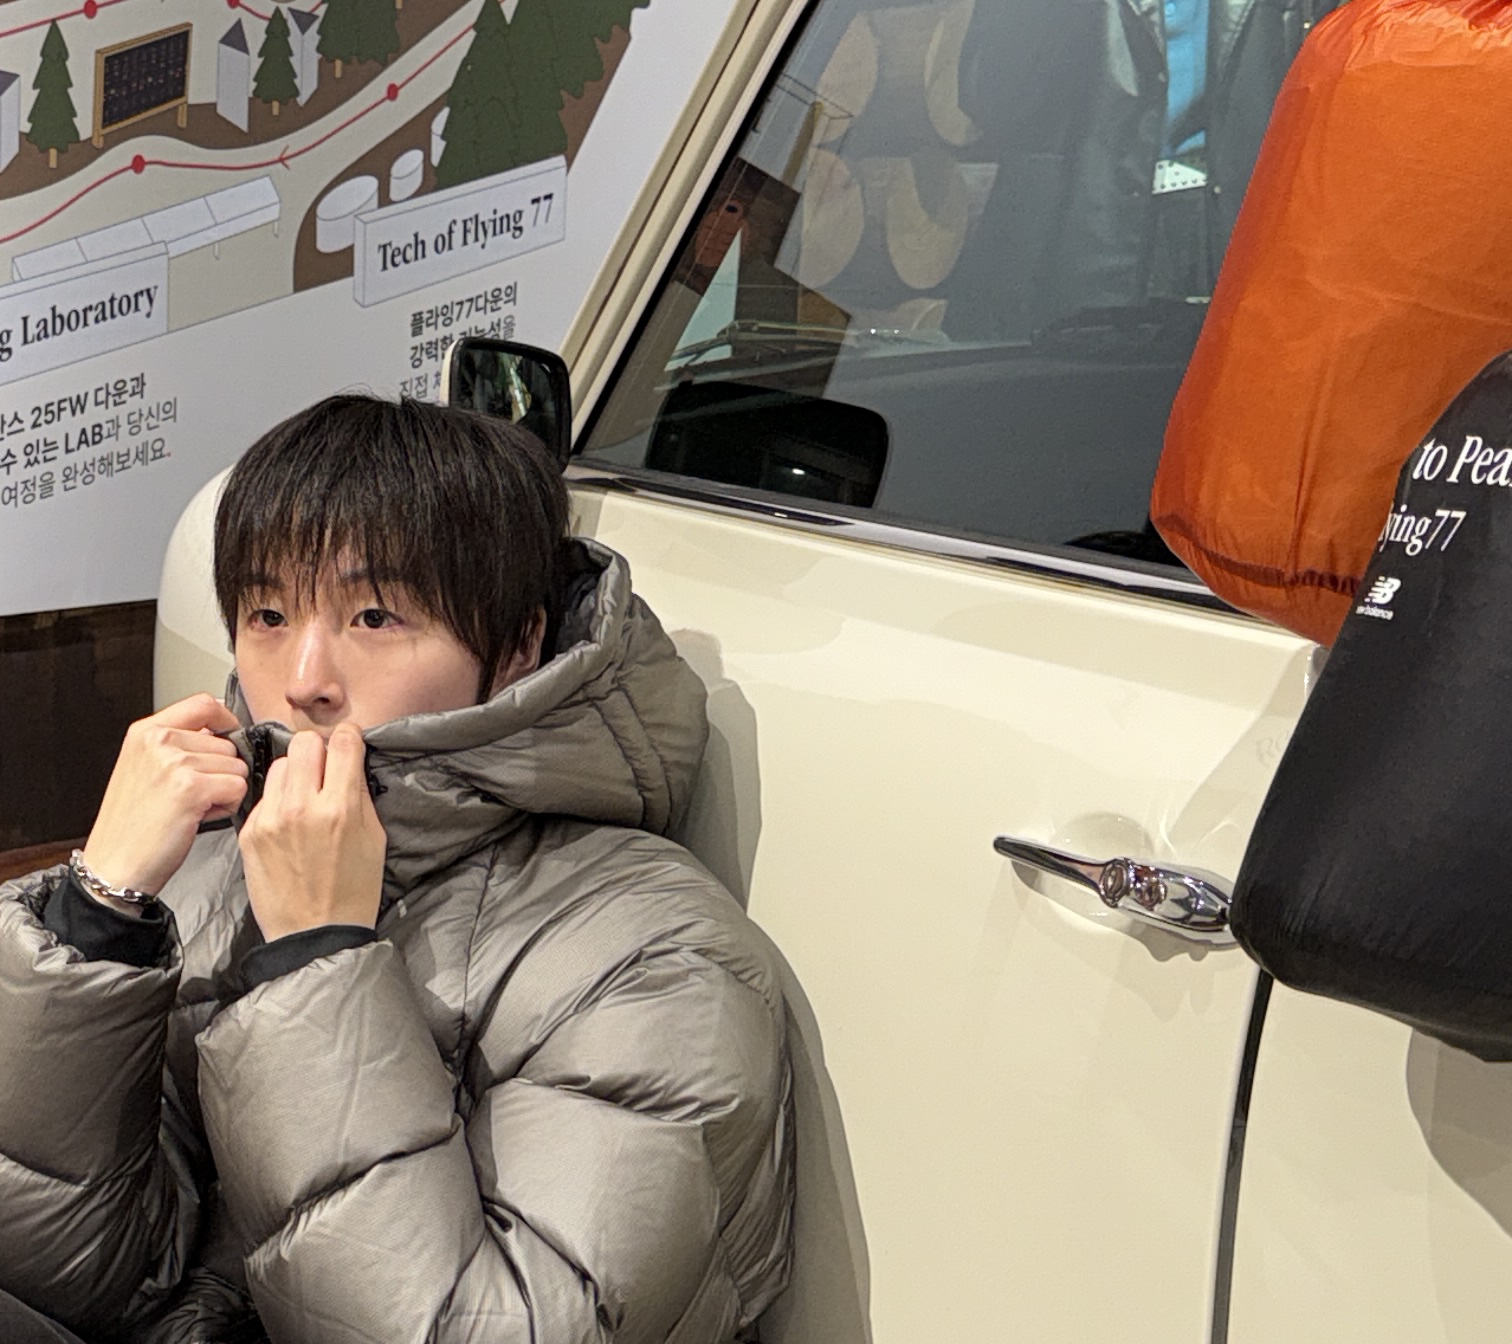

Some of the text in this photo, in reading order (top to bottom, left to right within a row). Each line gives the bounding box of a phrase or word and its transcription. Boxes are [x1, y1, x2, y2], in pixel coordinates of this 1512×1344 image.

[378, 193, 554, 272] Tech of Flying 77
[20, 285, 158, 346] Laboratory
[411, 281, 517, 337] 플라잉77다운의
[30, 392, 89, 430] 25FW
[94, 373, 146, 410] 다운과
[0, 448, 18, 475] 수
[24, 438, 59, 468] 있는
[64, 418, 121, 455] LAB과
[127, 397, 178, 436] 당신의
[1412, 435, 1512, 487] to Pea
[1, 471, 54, 508] 여정을
[61, 437, 171, 492] 완성해보세요.
